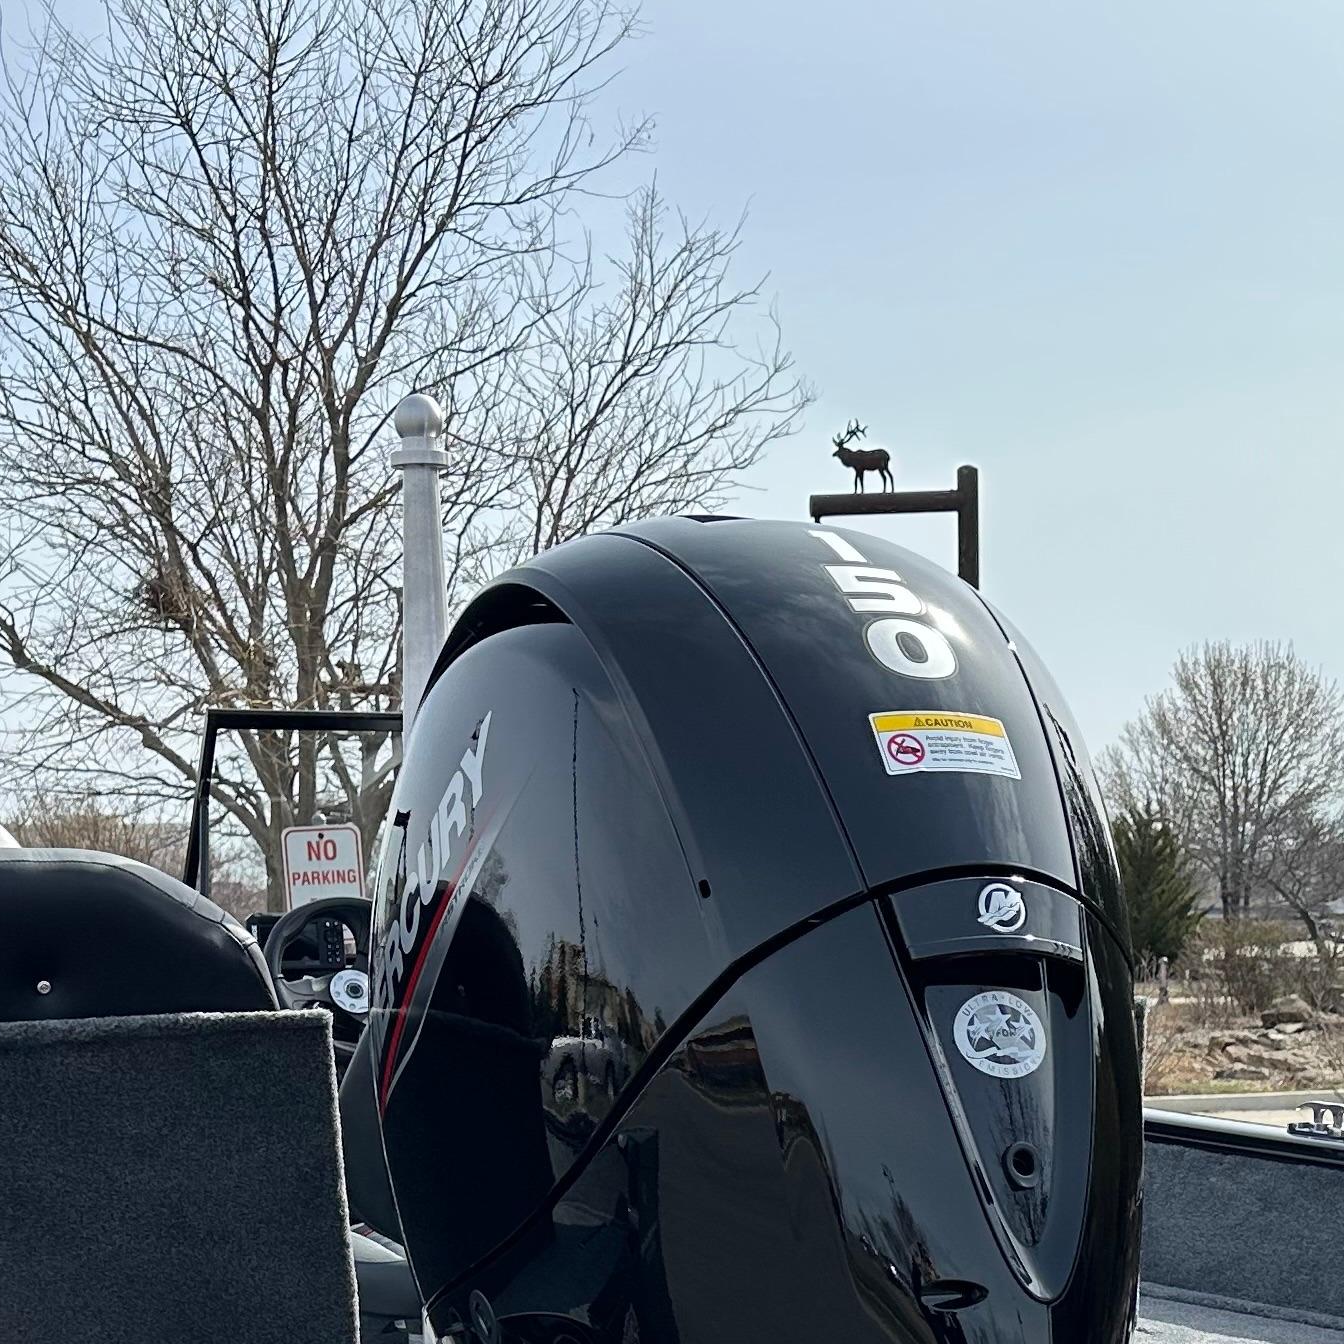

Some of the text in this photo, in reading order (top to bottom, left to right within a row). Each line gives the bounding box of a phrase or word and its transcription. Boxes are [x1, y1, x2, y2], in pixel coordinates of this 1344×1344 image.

[807, 529, 958, 681] 150
[925, 718, 973, 729] CAUTION
[306, 839, 337, 861] NO
[292, 869, 357, 886] PARKING
